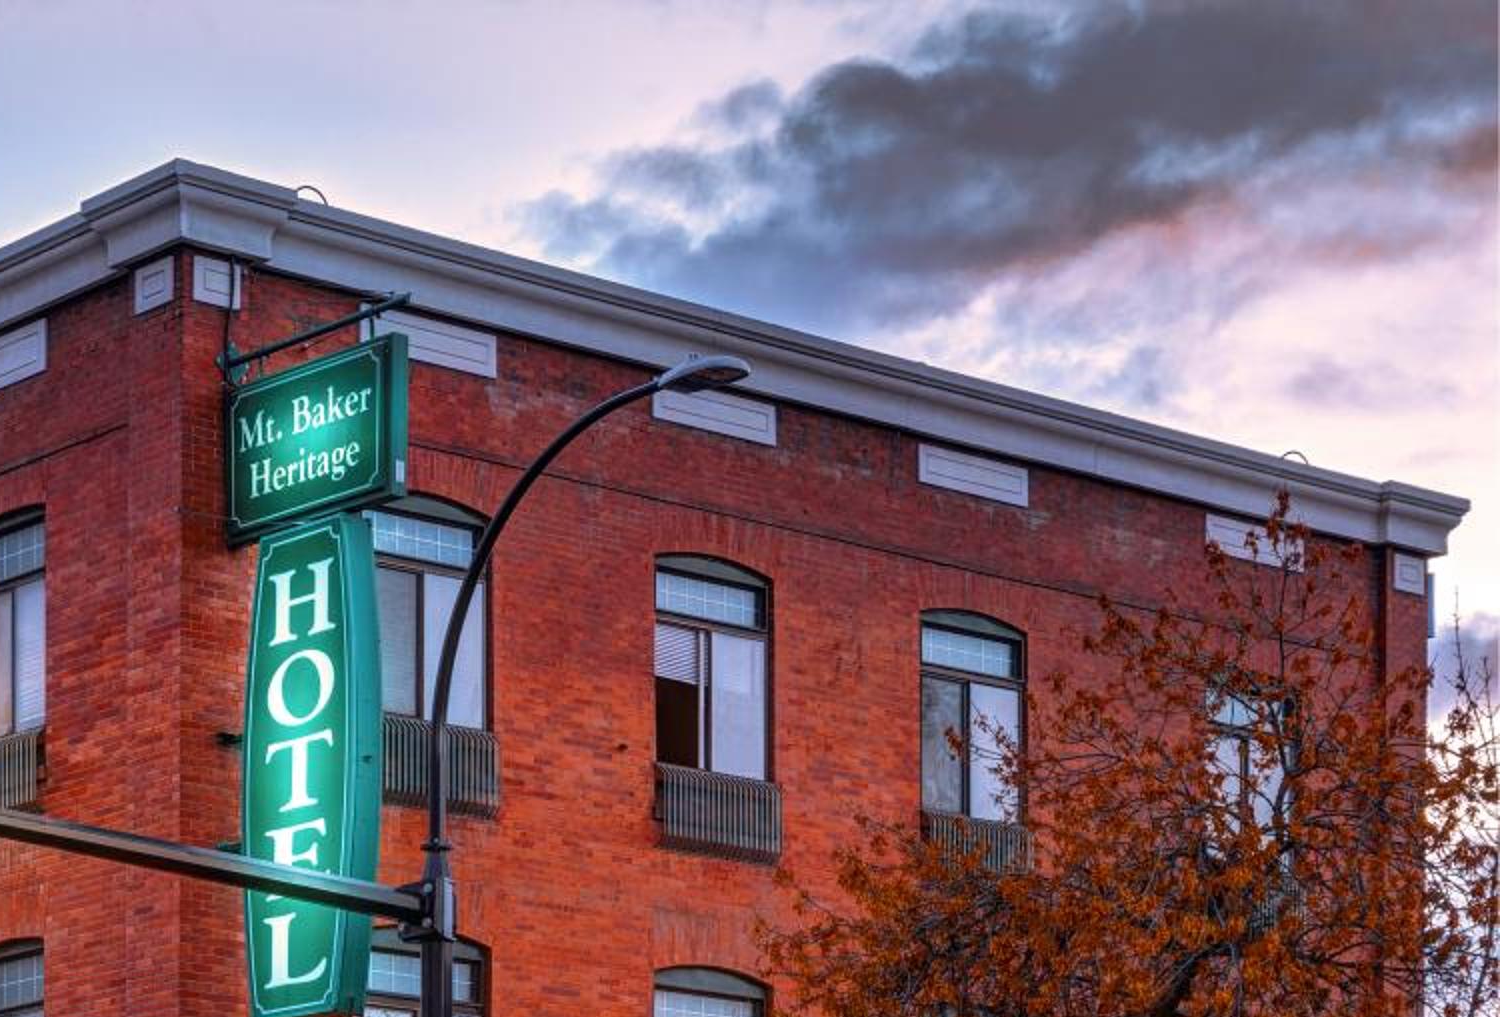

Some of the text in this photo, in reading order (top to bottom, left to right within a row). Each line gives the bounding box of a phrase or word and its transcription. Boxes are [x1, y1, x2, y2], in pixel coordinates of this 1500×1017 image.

[239, 385, 372, 453] Mt. Baker
[249, 441, 360, 499] Heritage
[264, 556, 336, 991] HOTEL
